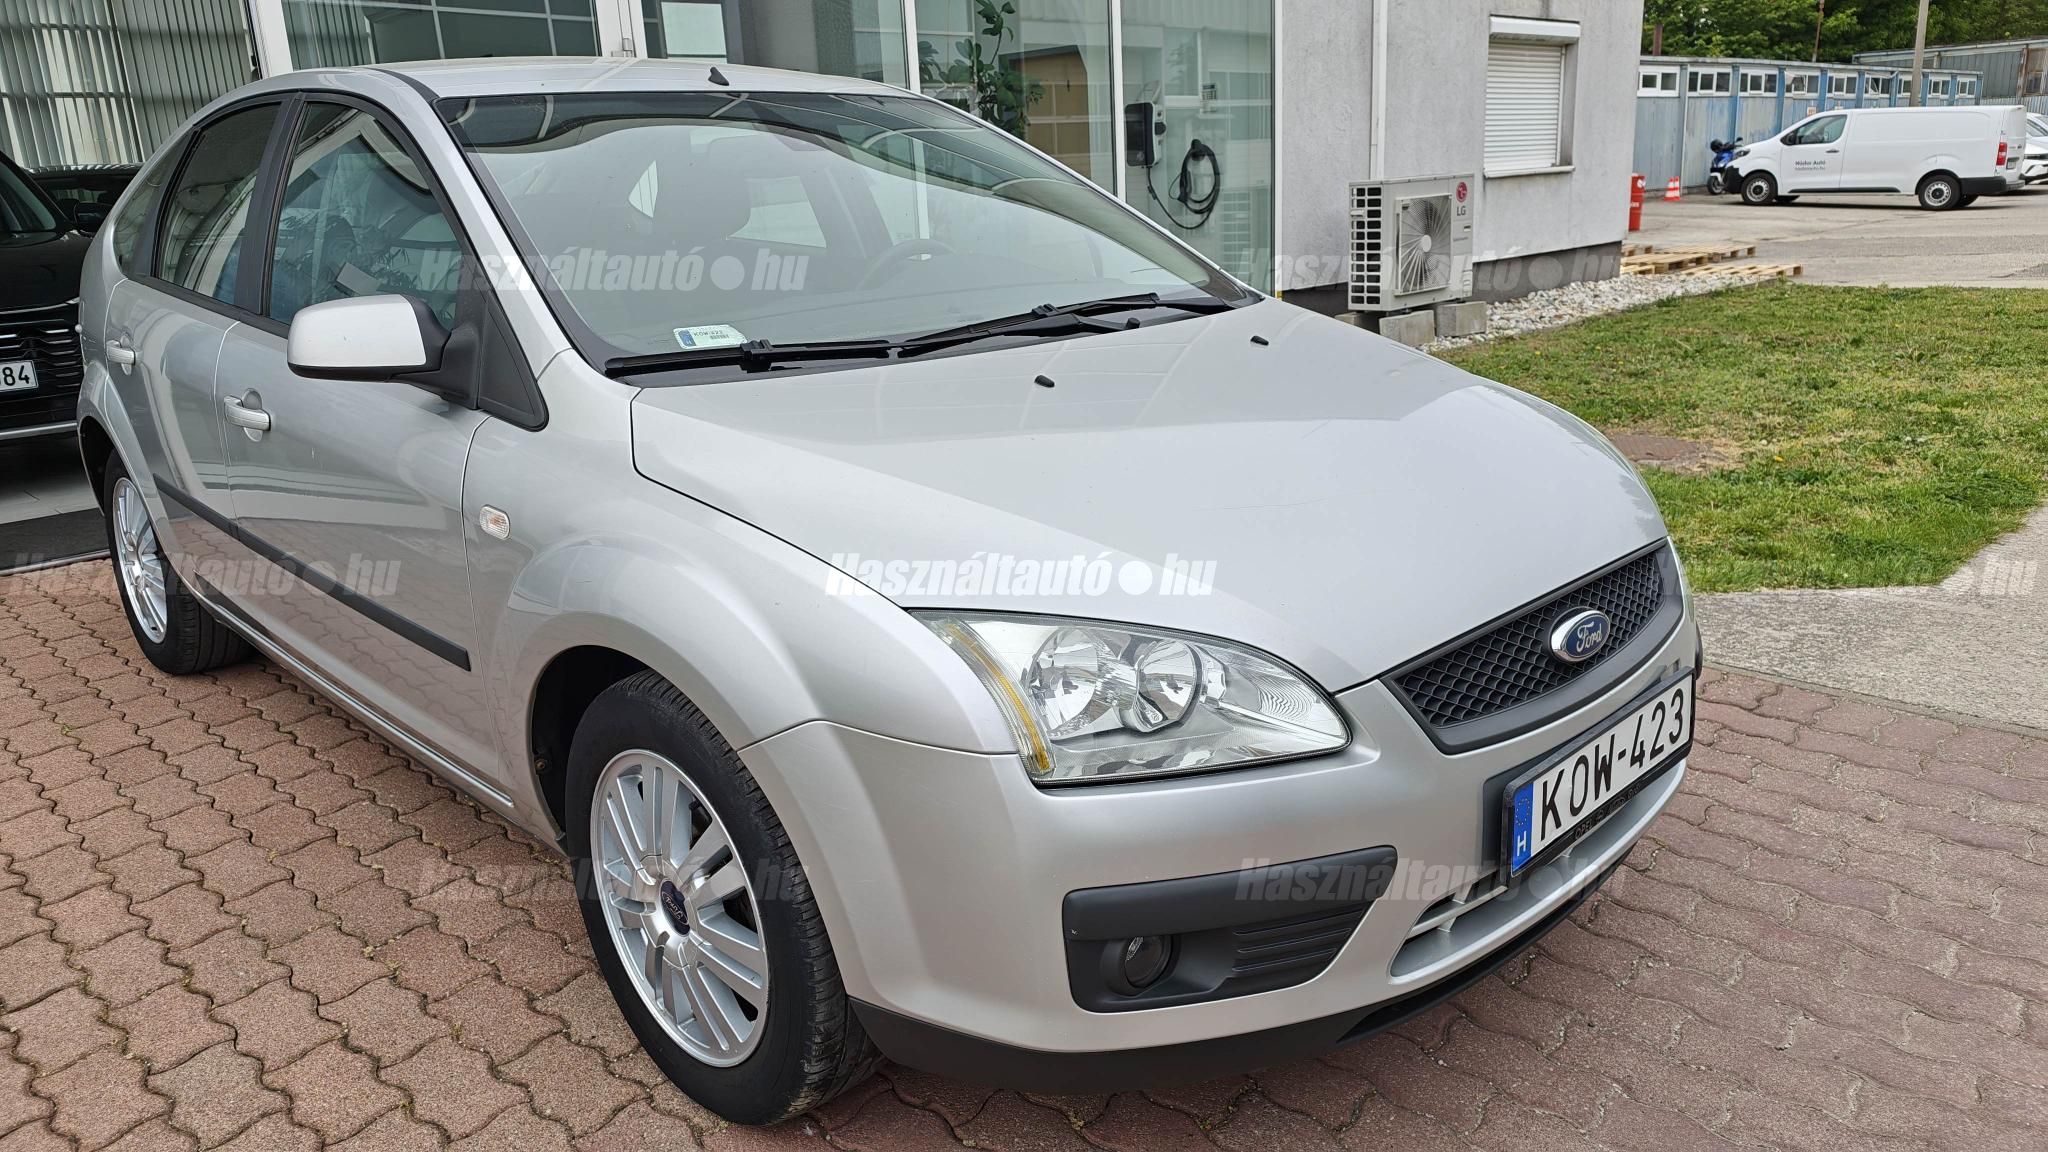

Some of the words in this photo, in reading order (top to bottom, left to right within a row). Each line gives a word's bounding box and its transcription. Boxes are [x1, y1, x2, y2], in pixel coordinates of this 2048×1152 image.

[1456, 206, 1467, 216] LG
[0, 366, 30, 387] 84
[1576, 621, 1603, 652] Ford
[1541, 688, 1684, 841] KOW-423
[1517, 831, 1527, 857] H
